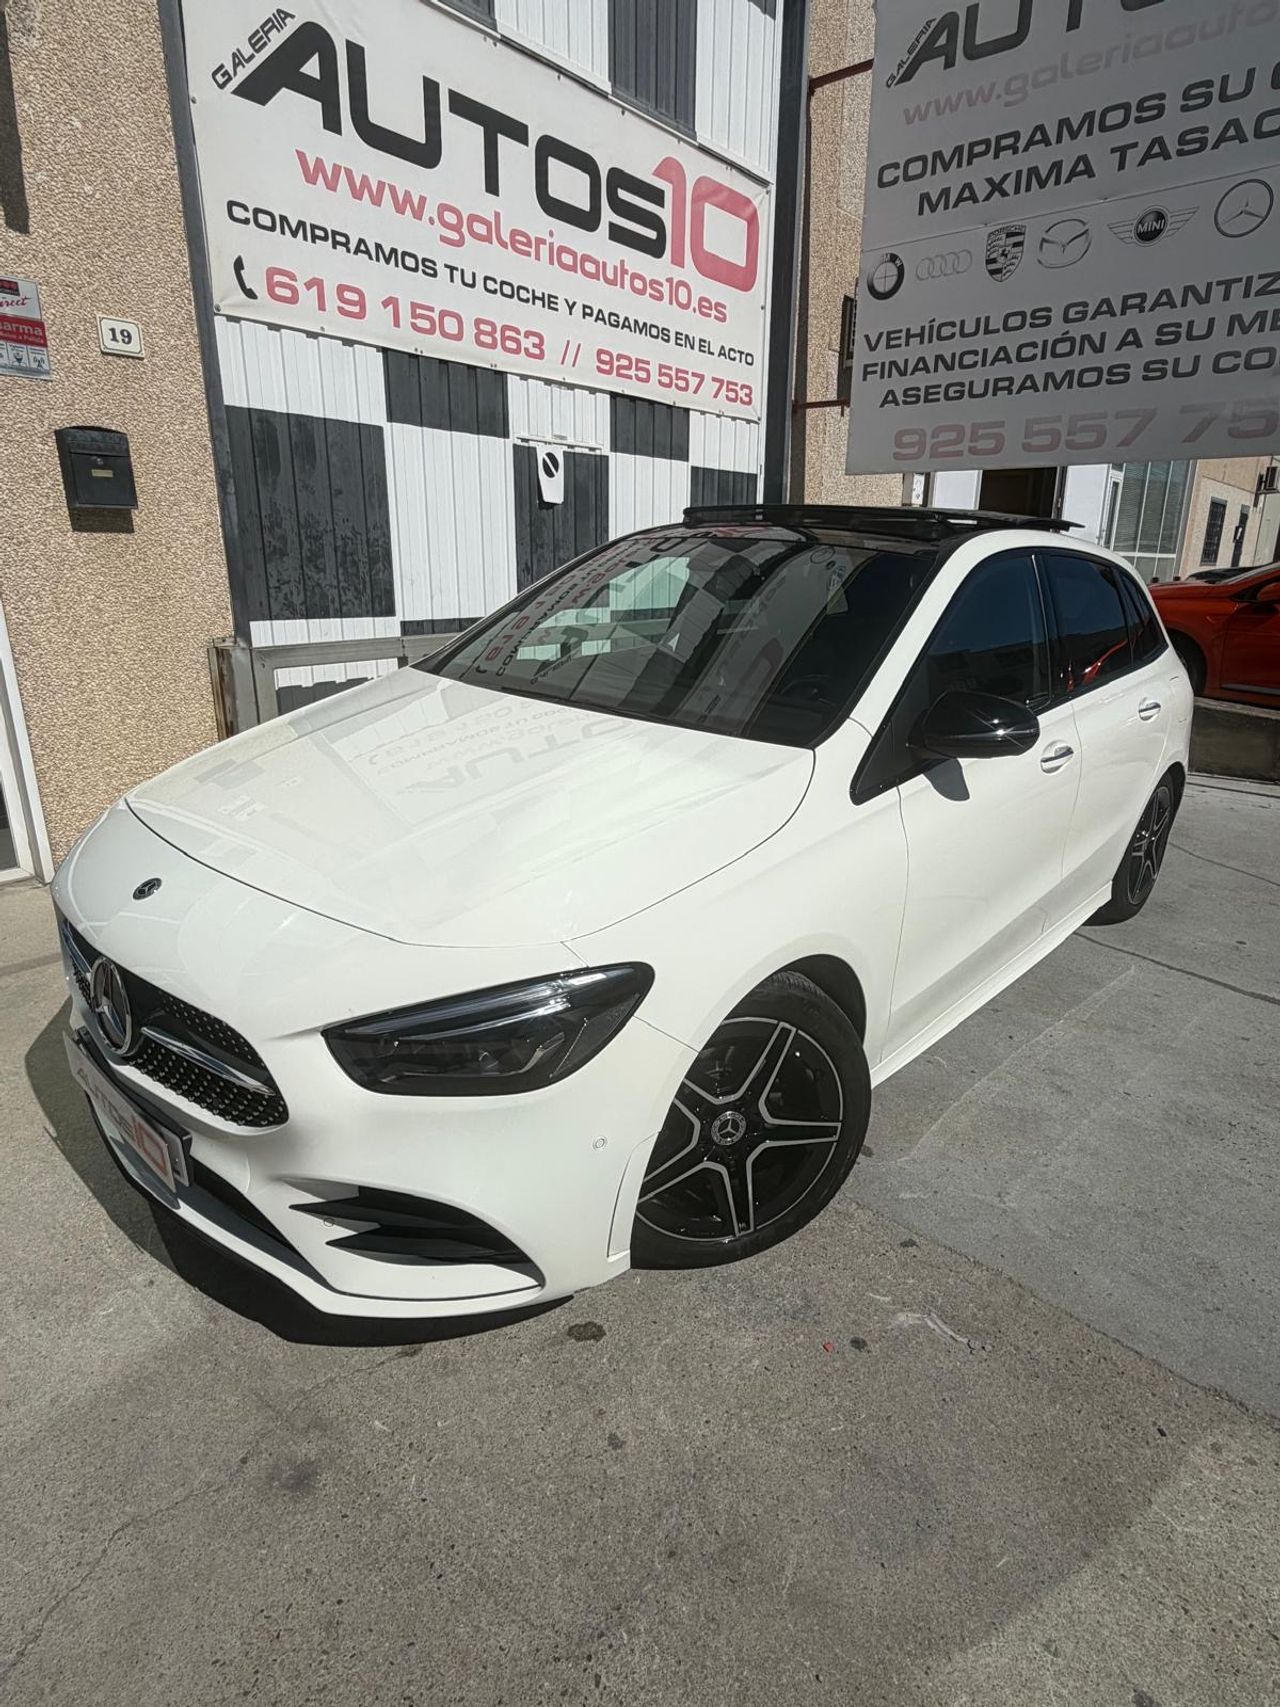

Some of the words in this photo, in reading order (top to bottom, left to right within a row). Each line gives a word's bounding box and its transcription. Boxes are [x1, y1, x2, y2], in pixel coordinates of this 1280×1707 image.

[211, 8, 296, 90] GALERIA
[886, 17, 937, 88] GALERIA
[877, 92, 1167, 188] COMPRAMOS
[1180, 67, 1257, 112] SU
[918, 153, 1096, 216] MAXIMA
[295, 149, 727, 323] www.galeriaautos10.es
[1137, 219, 1165, 234] MINI
[226, 200, 438, 278] COMPRAMOS
[444, 264, 477, 289] TU
[483, 275, 559, 312] COCHE
[564, 298, 577, 316] Y
[582, 303, 671, 344] PAGAMOS
[674, 331, 695, 350] EN
[698, 338, 715, 356] EL
[717, 345, 755, 366] ACTO
[863, 306, 1053, 352] VEHÍCULOS
[1062, 271, 1280, 324] GARANTIZ
[108, 327, 133, 345] 19
[265, 266, 367, 320] 619
[381, 295, 464, 342] 150
[474, 317, 545, 360] 863
[596, 348, 651, 384] 925
[658, 363, 705, 394] 557
[711, 376, 753, 406] 753
[862, 329, 1107, 381] FINANCIACIÓN
[1115, 328, 1144, 351] A
[1155, 317, 1216, 346] SU
[879, 363, 1131, 408] ASEGURAMOS
[1142, 354, 1201, 382] SU
[1211, 346, 1280, 374] CO
[893, 420, 1006, 461] 925
[1021, 407, 1158, 453] 557
